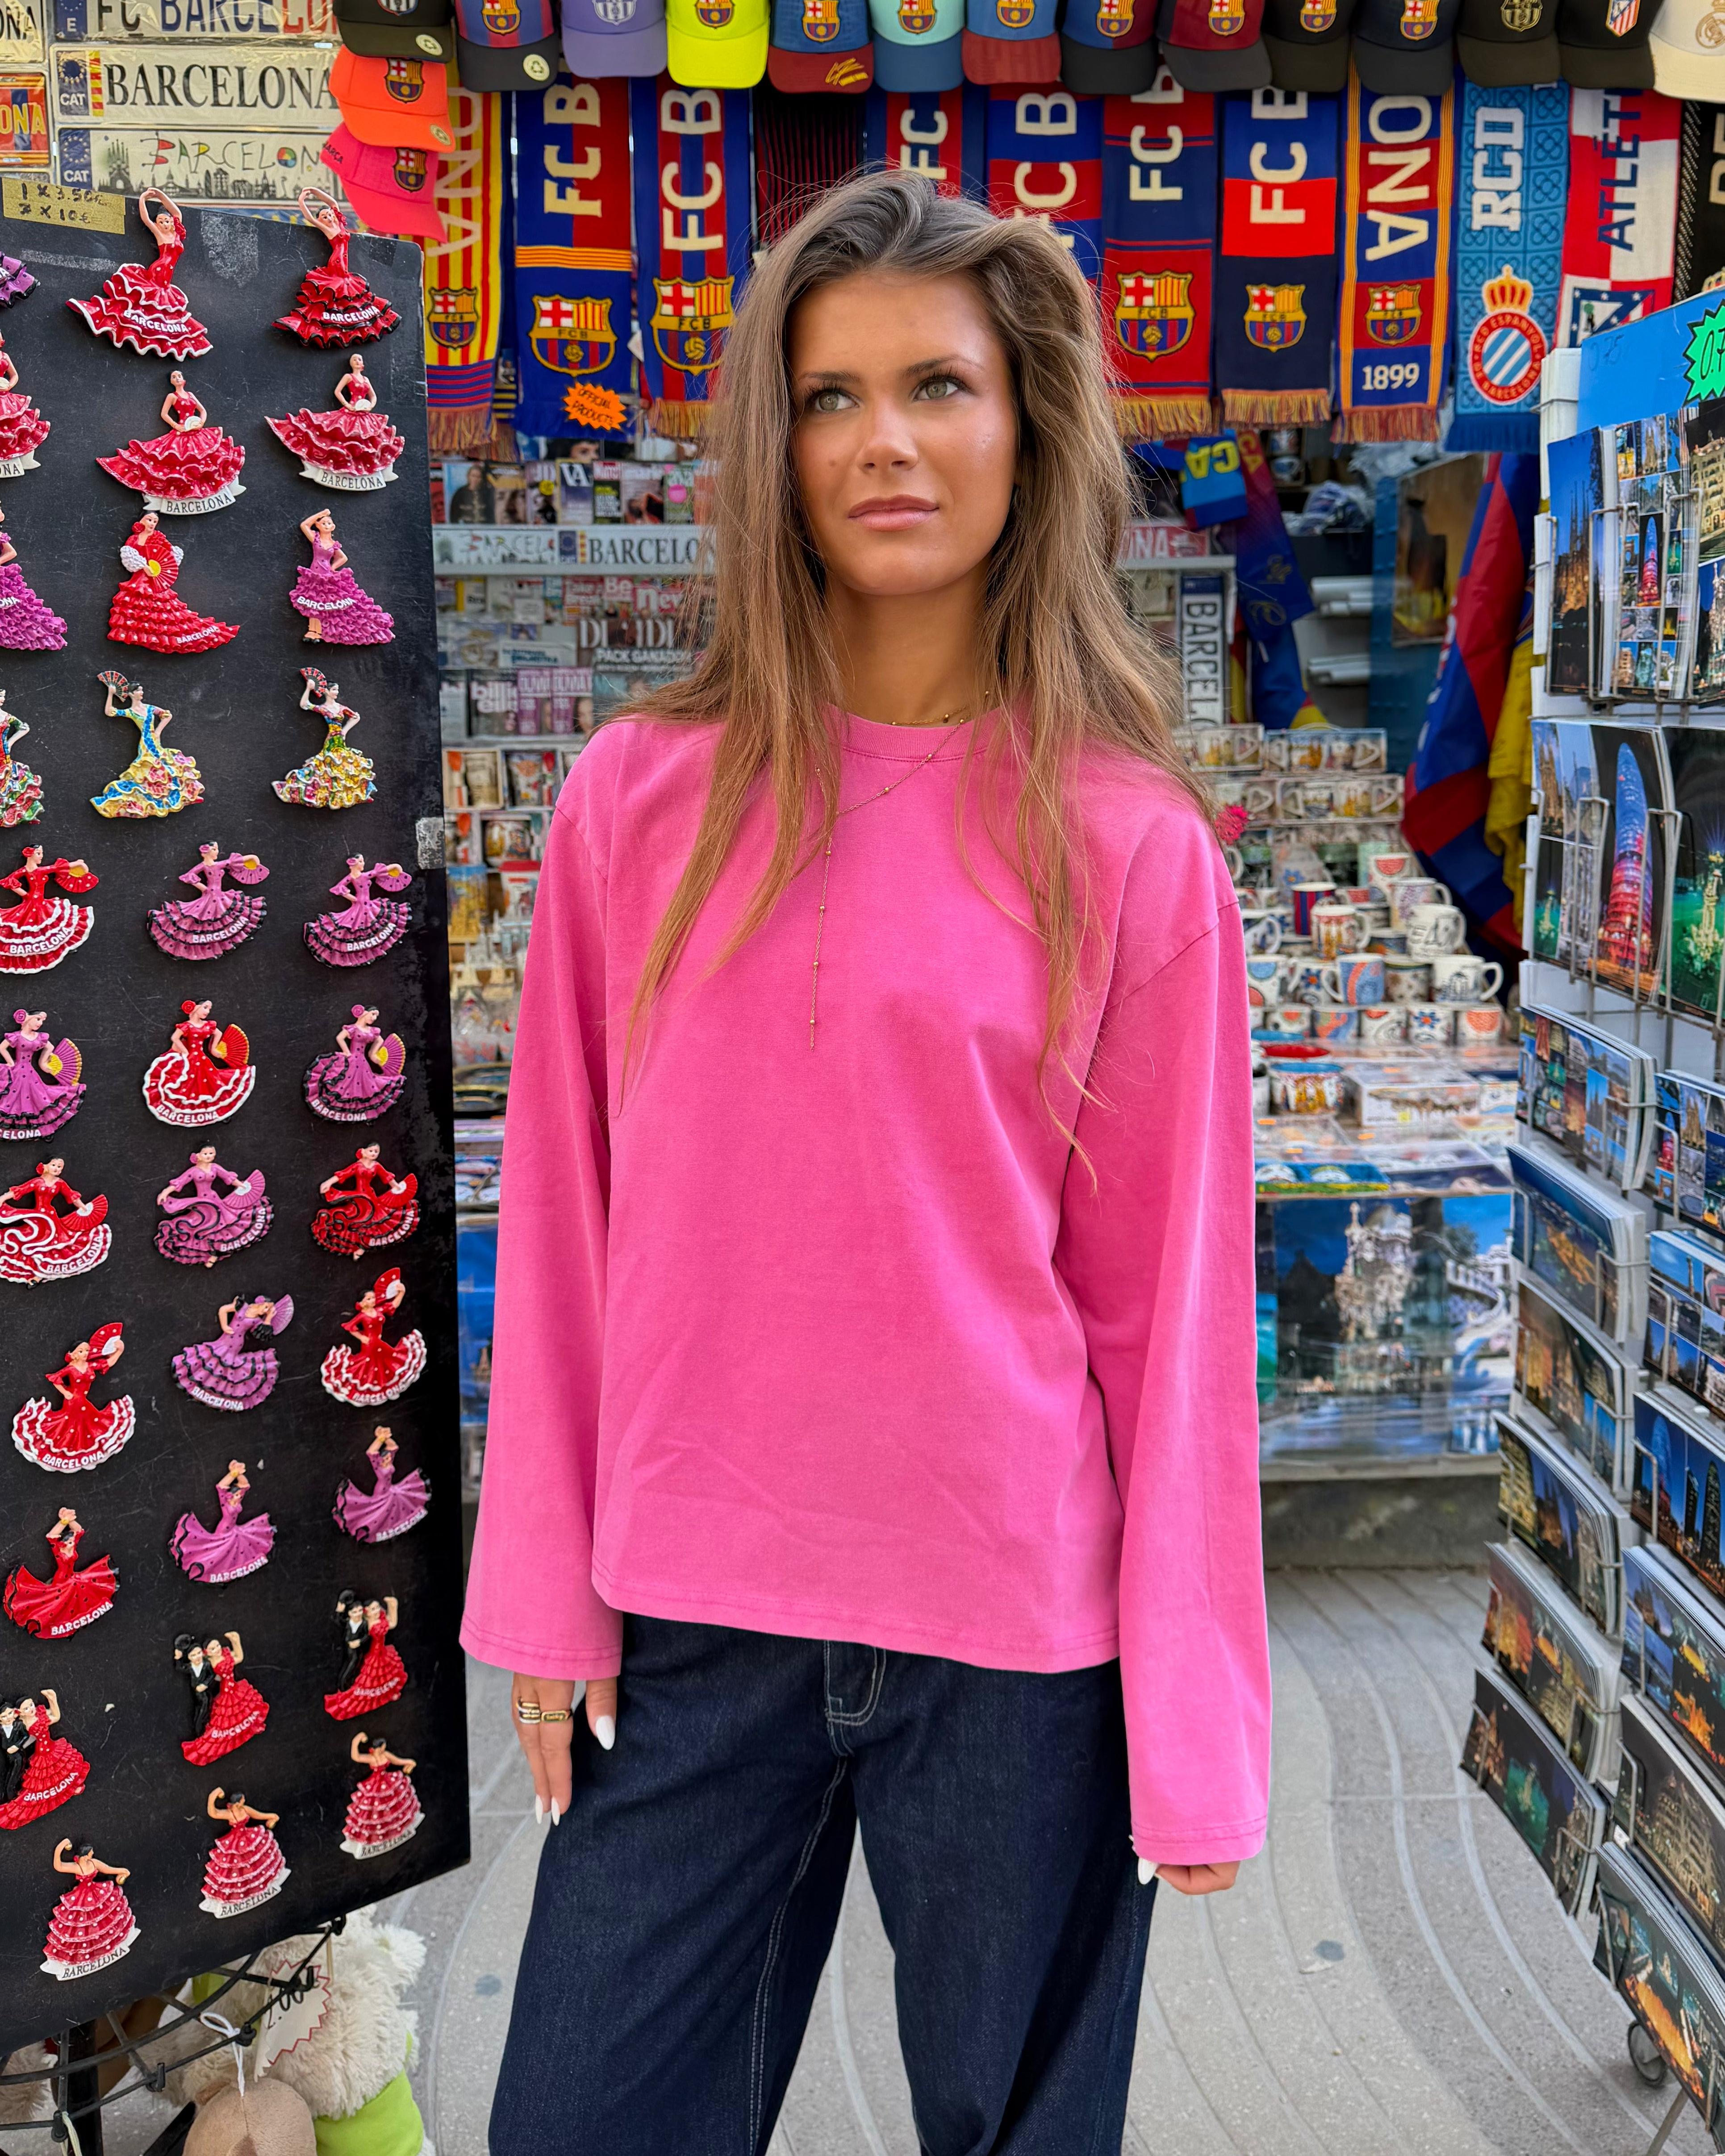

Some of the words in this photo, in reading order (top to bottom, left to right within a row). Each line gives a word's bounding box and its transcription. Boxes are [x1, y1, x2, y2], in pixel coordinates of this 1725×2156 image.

[67, 17, 77, 32] E
[104, 63, 339, 109] BARCELONA
[60, 93, 85, 106] CAT
[64, 170, 89, 182] CAT
[1471, 106, 1525, 231] RCD
[21, 182, 27, 200] 1
[123, 309, 191, 333] BARCELONA
[322, 305, 380, 323] BARCELONA
[678, 317, 710, 330] FCB
[1362, 363, 1420, 390] 1899
[321, 472, 384, 489] BARCELONA
[166, 495, 230, 514] BARCELONA
[297, 596, 357, 611] BARCELONA
[177, 626, 220, 644] BARCELONA
[10, 927, 72, 954] BARCELONA
[192, 916, 249, 944] BARCELONA
[347, 922, 397, 952] BARCELONA
[156, 1105, 219, 1124] BARCELONA
[311, 1099, 367, 1121] BARCELONA
[220, 1207, 266, 1252] BARCELONA
[369, 1210, 414, 1247] BARCELONA
[46, 1235, 104, 1273] BARCELONA
[192, 1386, 244, 1412] BARCELONA
[352, 1383, 405, 1404] BARCELONA
[42, 1450, 105, 1469] BARCELONA
[376, 1508, 429, 1542] BARCELONA
[209, 1556, 269, 1584] BARCELONA
[51, 1601, 114, 1636] BARCELONA
[24, 1772, 79, 1801] BARCELONA
